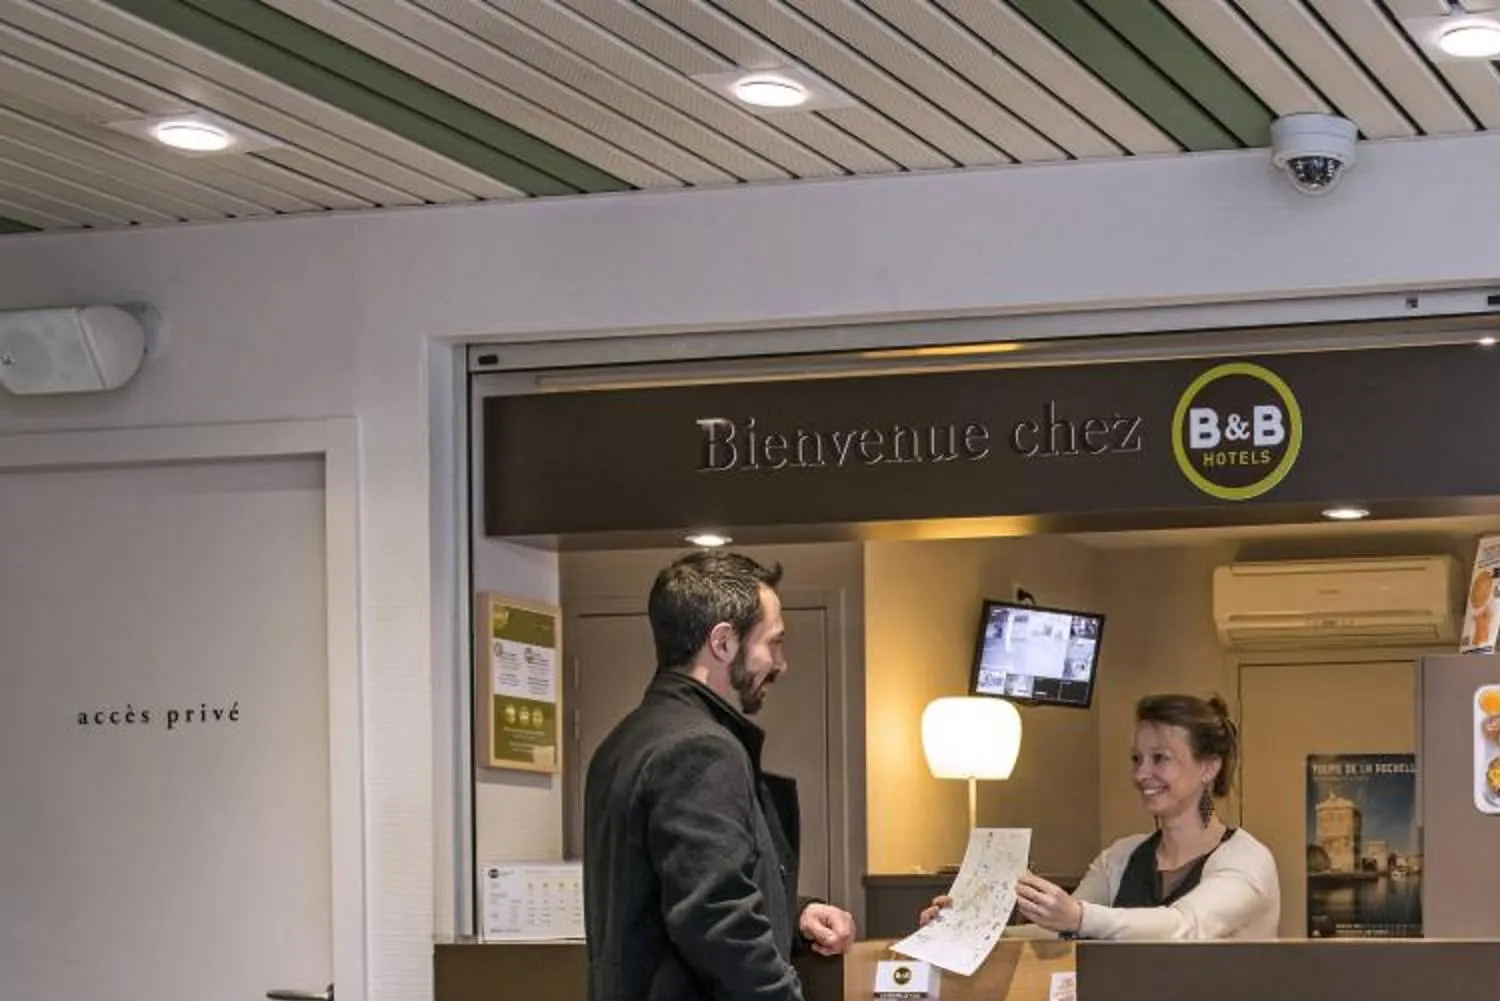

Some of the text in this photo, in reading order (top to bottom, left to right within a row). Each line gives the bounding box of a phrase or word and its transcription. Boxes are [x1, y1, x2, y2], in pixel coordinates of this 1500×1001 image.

[696, 400, 1142, 472] Bienvenue chez
[1189, 404, 1286, 449] B&B
[1202, 449, 1272, 467] HOTELS
[77, 702, 240, 730] accès privé
